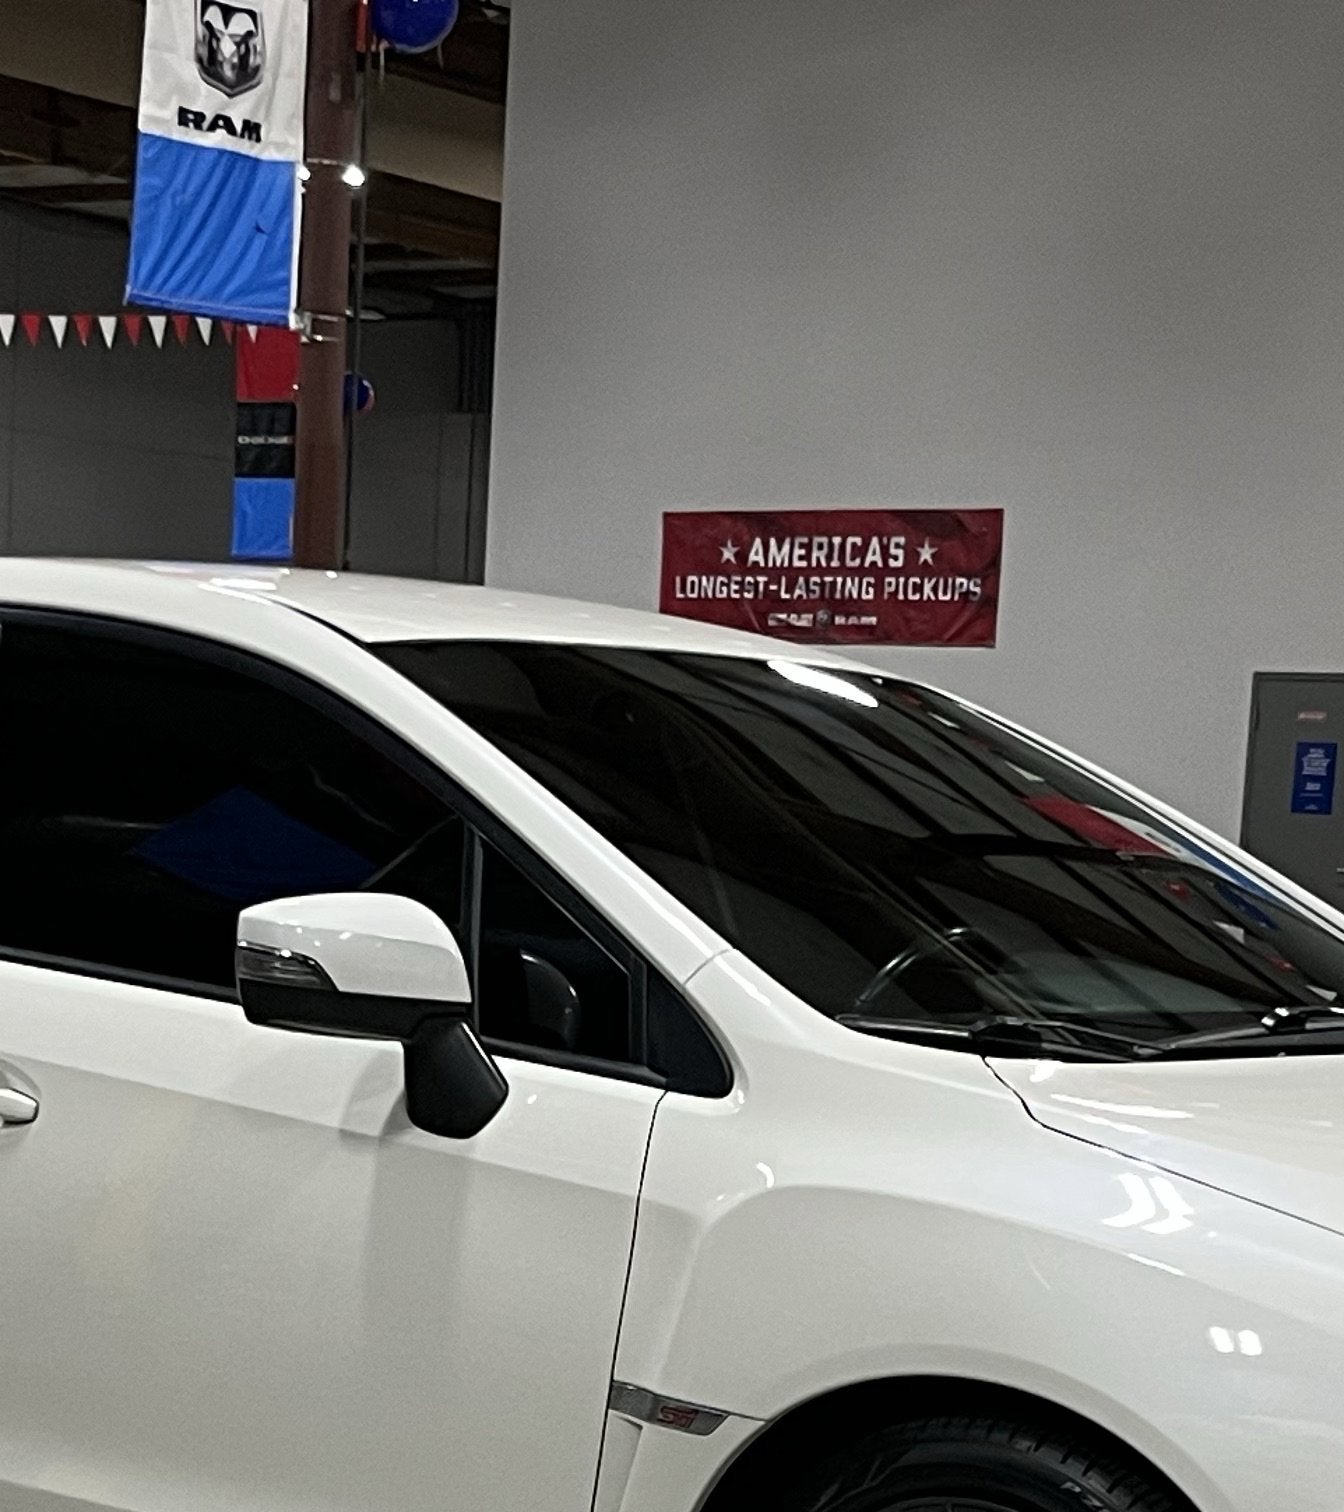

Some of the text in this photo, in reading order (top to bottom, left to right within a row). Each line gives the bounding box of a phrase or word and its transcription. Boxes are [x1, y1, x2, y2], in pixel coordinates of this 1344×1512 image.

[177, 105, 262, 143] RAM
[746, 536, 906, 568] AMERICA'S
[675, 575, 982, 601] LONGEST-LASTING PICKUPS
